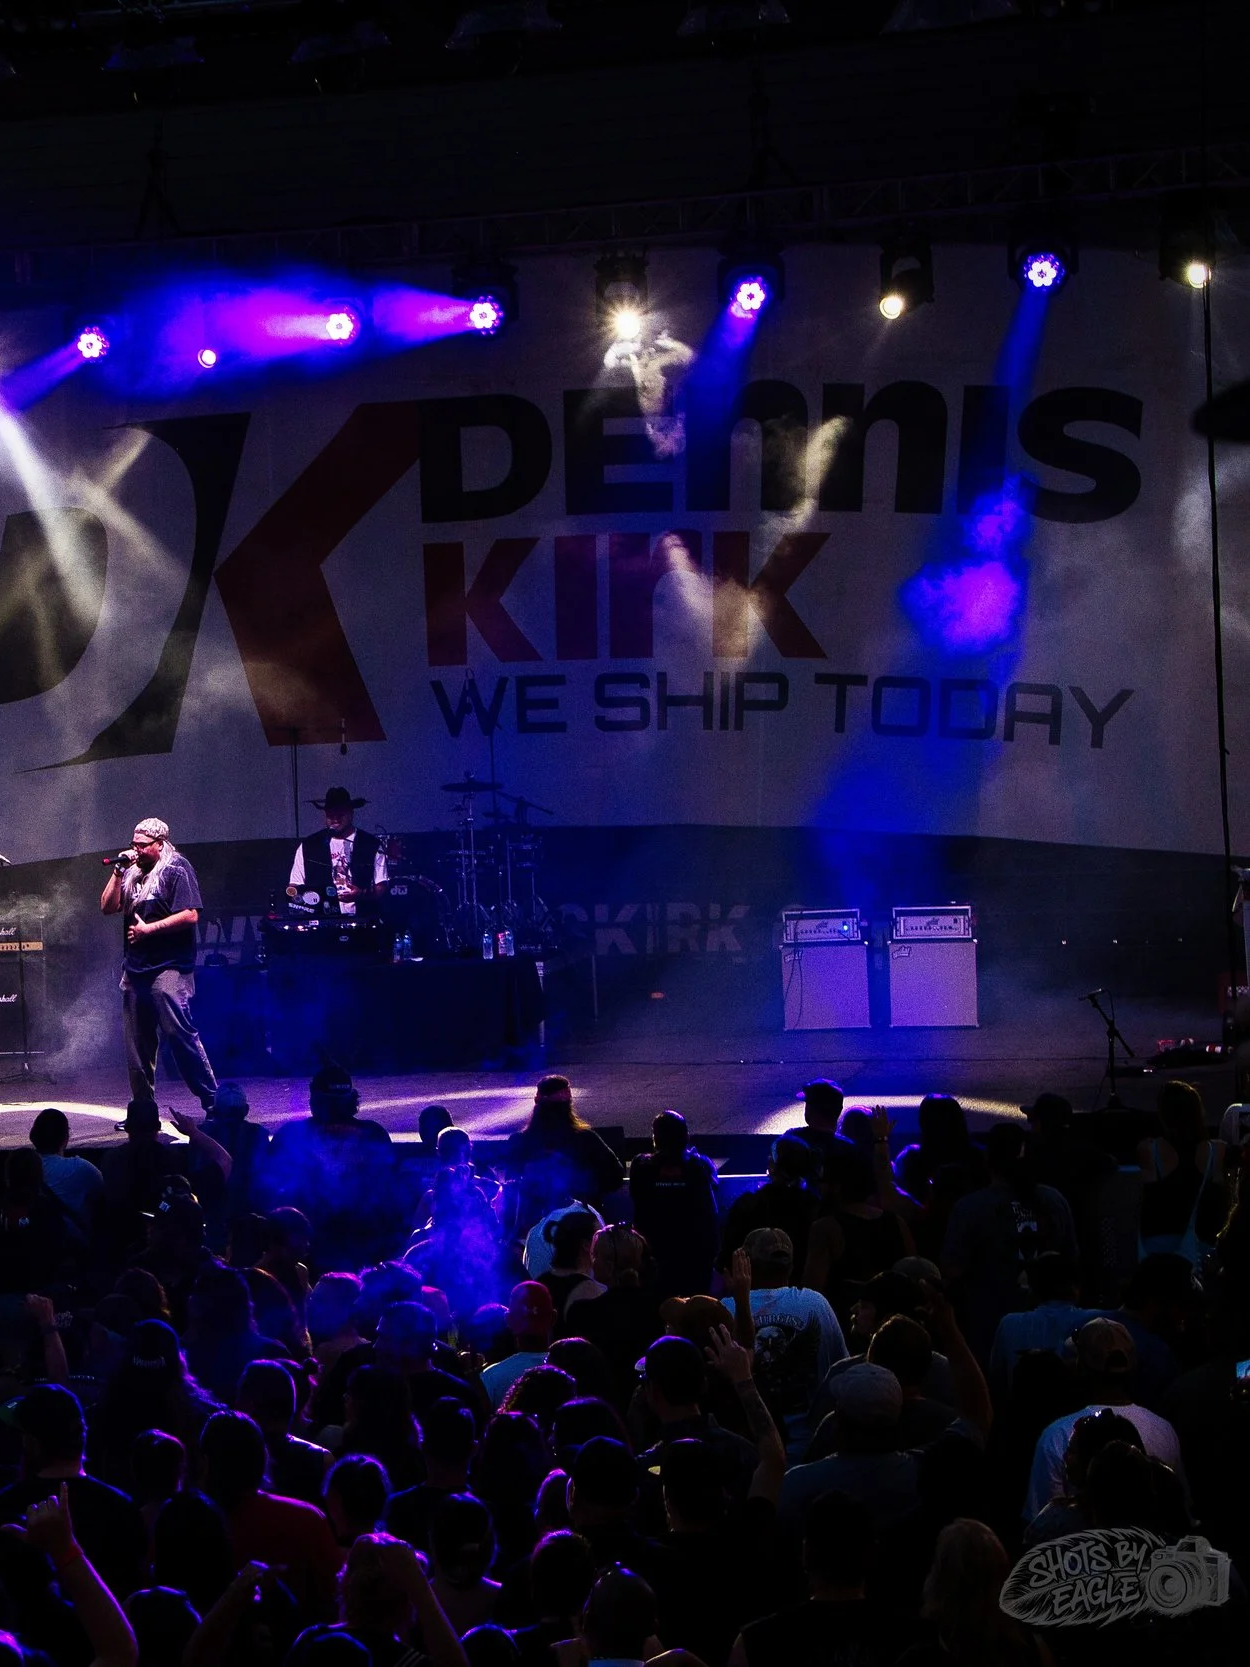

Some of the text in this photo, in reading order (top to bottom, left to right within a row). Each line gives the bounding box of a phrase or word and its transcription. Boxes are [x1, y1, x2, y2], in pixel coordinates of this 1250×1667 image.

[430, 672, 1134, 749] WE SHIP TODAY
